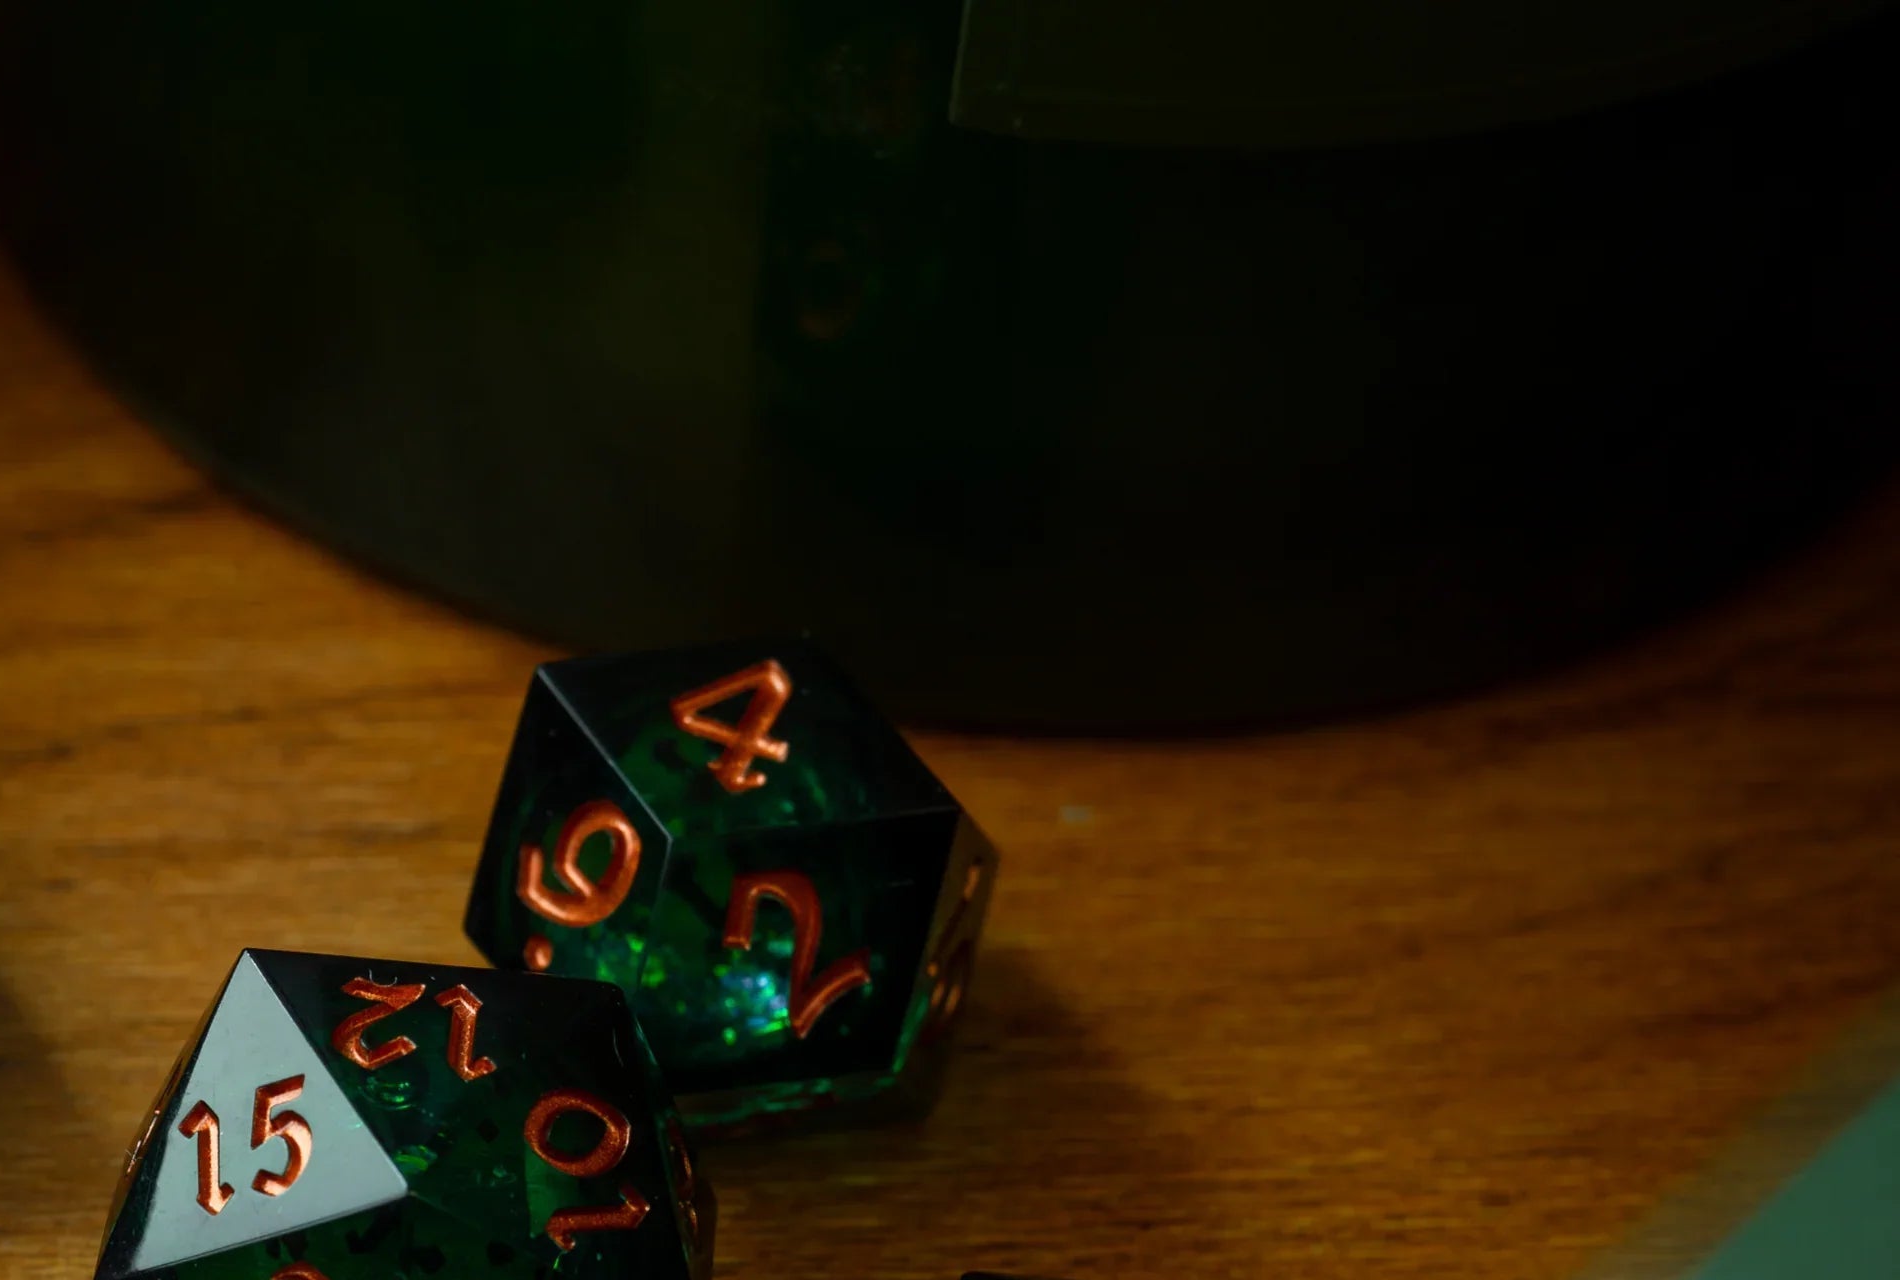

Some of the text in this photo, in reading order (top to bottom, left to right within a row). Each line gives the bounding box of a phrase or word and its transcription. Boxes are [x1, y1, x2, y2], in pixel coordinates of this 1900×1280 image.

[670, 658, 793, 793] 4
[722, 868, 874, 1041] 2
[331, 976, 497, 1083] 12
[178, 1075, 313, 1216] 15
